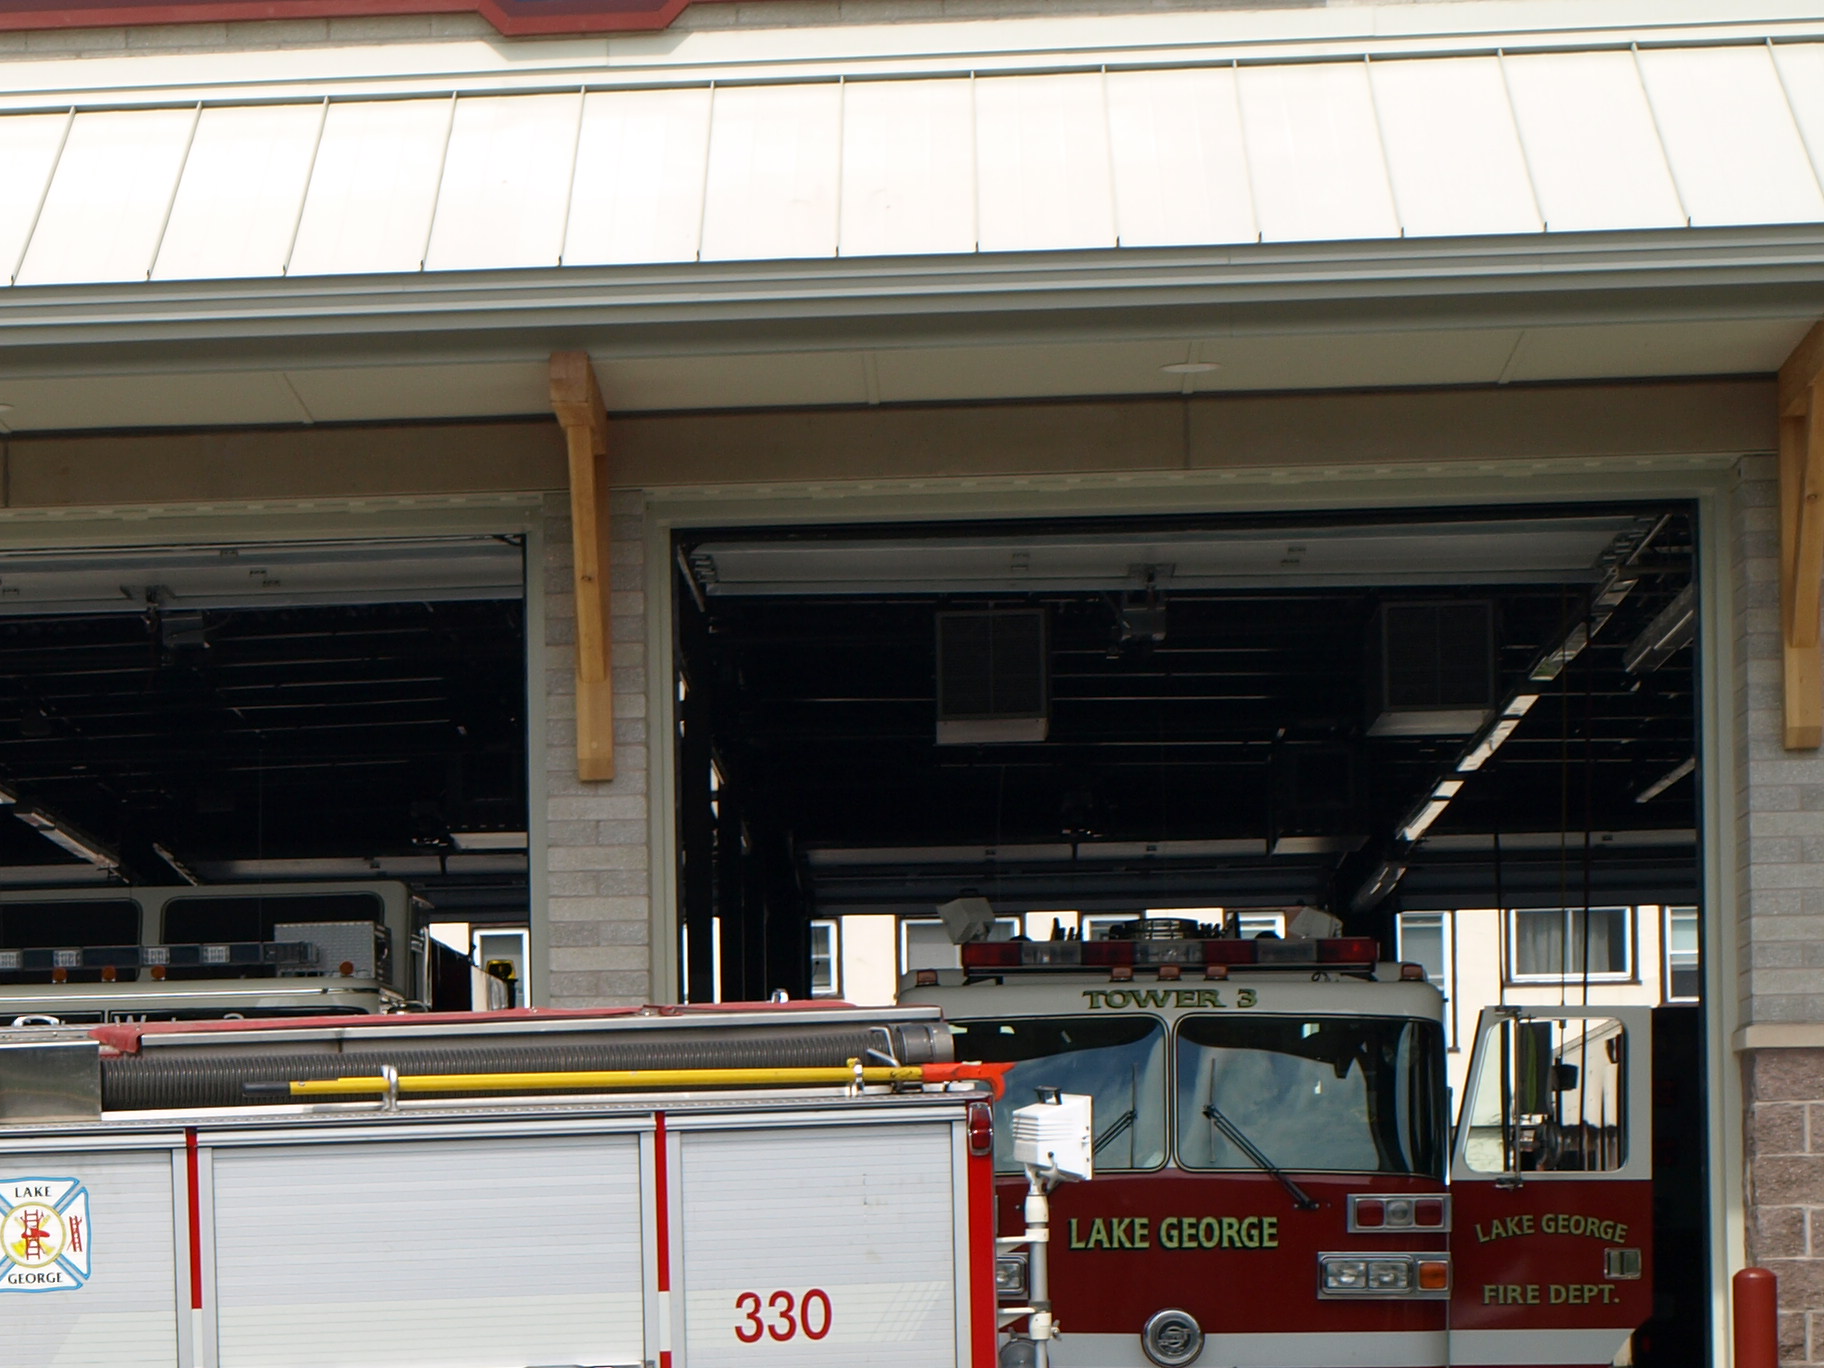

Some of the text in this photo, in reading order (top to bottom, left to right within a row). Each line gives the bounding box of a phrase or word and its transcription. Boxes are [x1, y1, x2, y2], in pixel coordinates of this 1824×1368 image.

[1082, 988, 1258, 1010] TOWER 3
[15, 1186, 52, 1198] LAKE
[1069, 1215, 1280, 1250] LAKE GEORGE
[1475, 1213, 1630, 1244] LAKE GEORGE
[8, 1272, 63, 1285] GEORGE
[1483, 1284, 1621, 1305] FIRE DEPT.
[734, 1288, 833, 1344] 330
